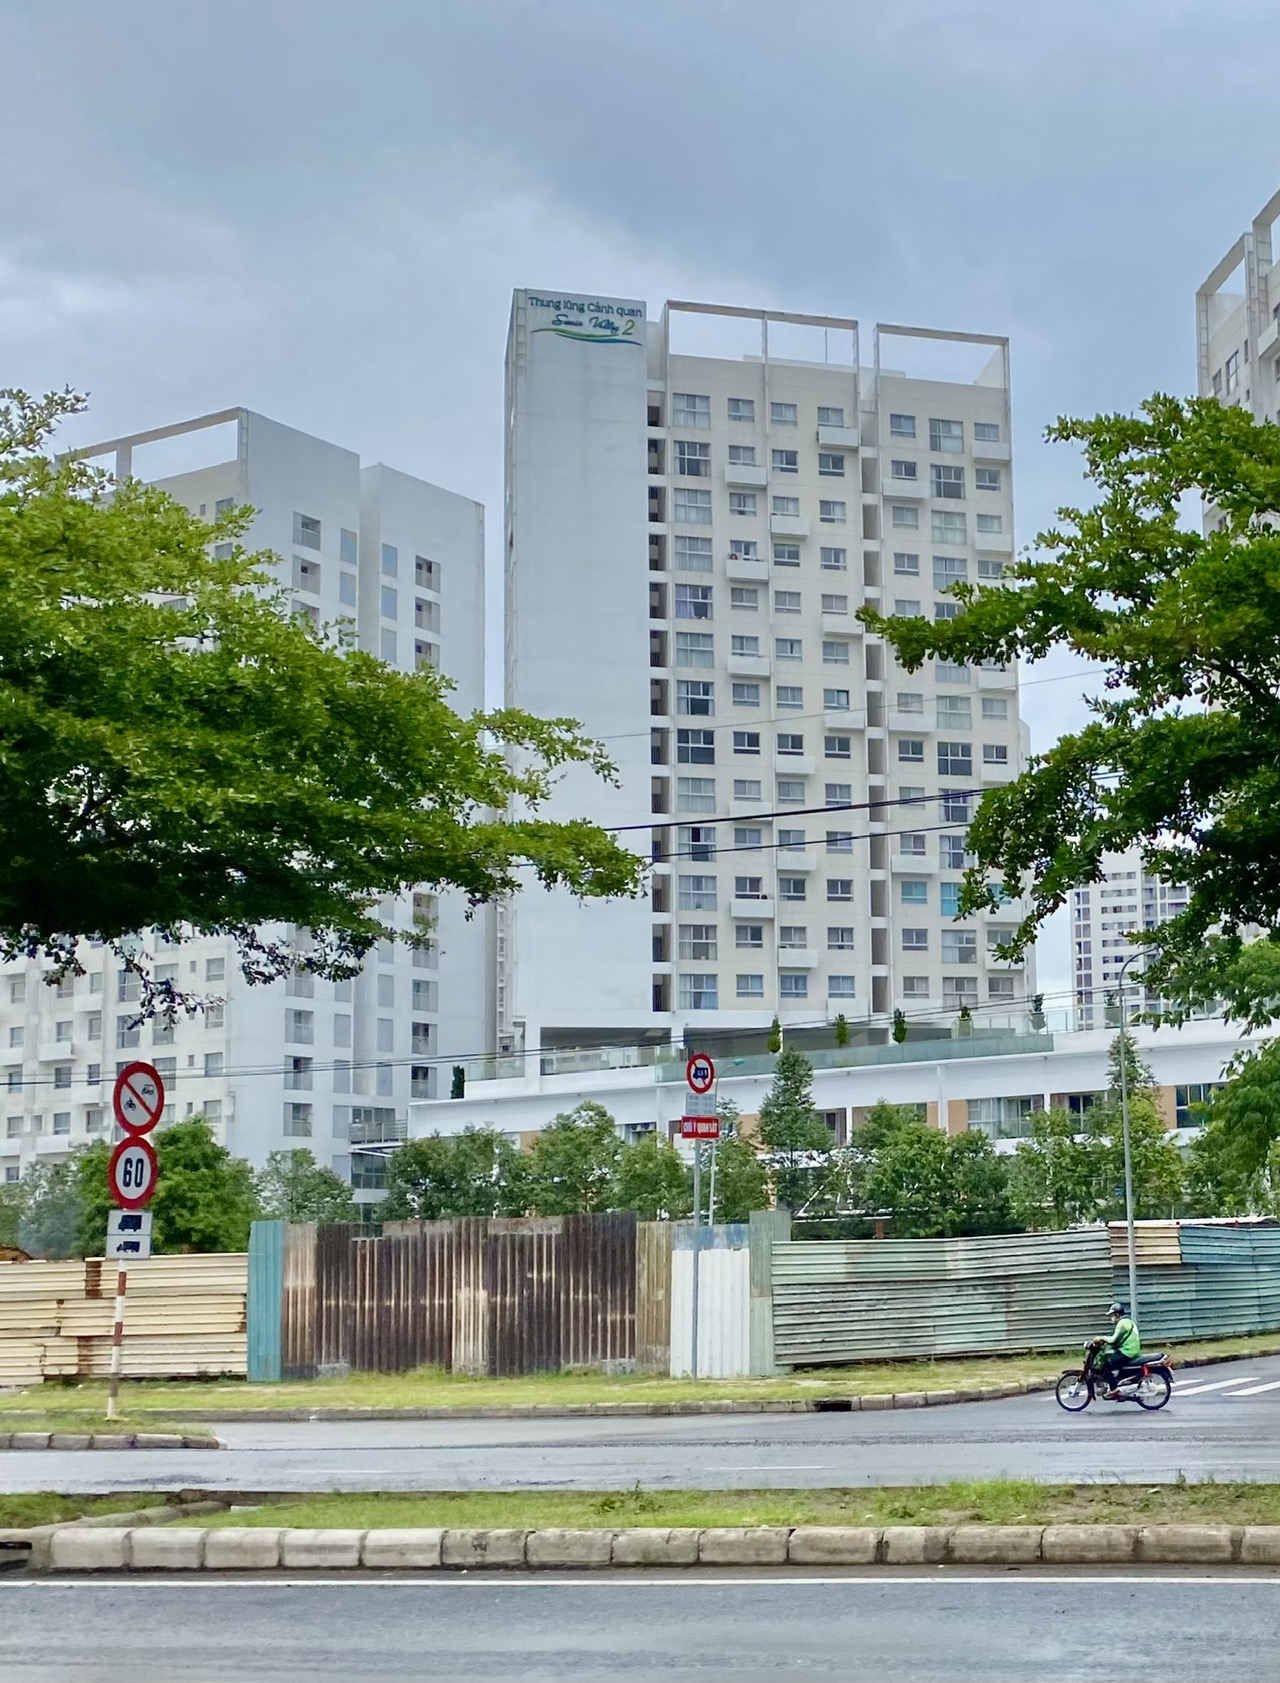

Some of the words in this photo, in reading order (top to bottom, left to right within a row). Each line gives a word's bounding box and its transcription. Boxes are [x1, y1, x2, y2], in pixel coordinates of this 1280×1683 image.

[528, 296, 562, 311] Thung
[563, 300, 585, 313] lũng
[616, 305, 643, 317] quan
[621, 319, 635, 335] 2
[122, 1157, 144, 1187] 60
